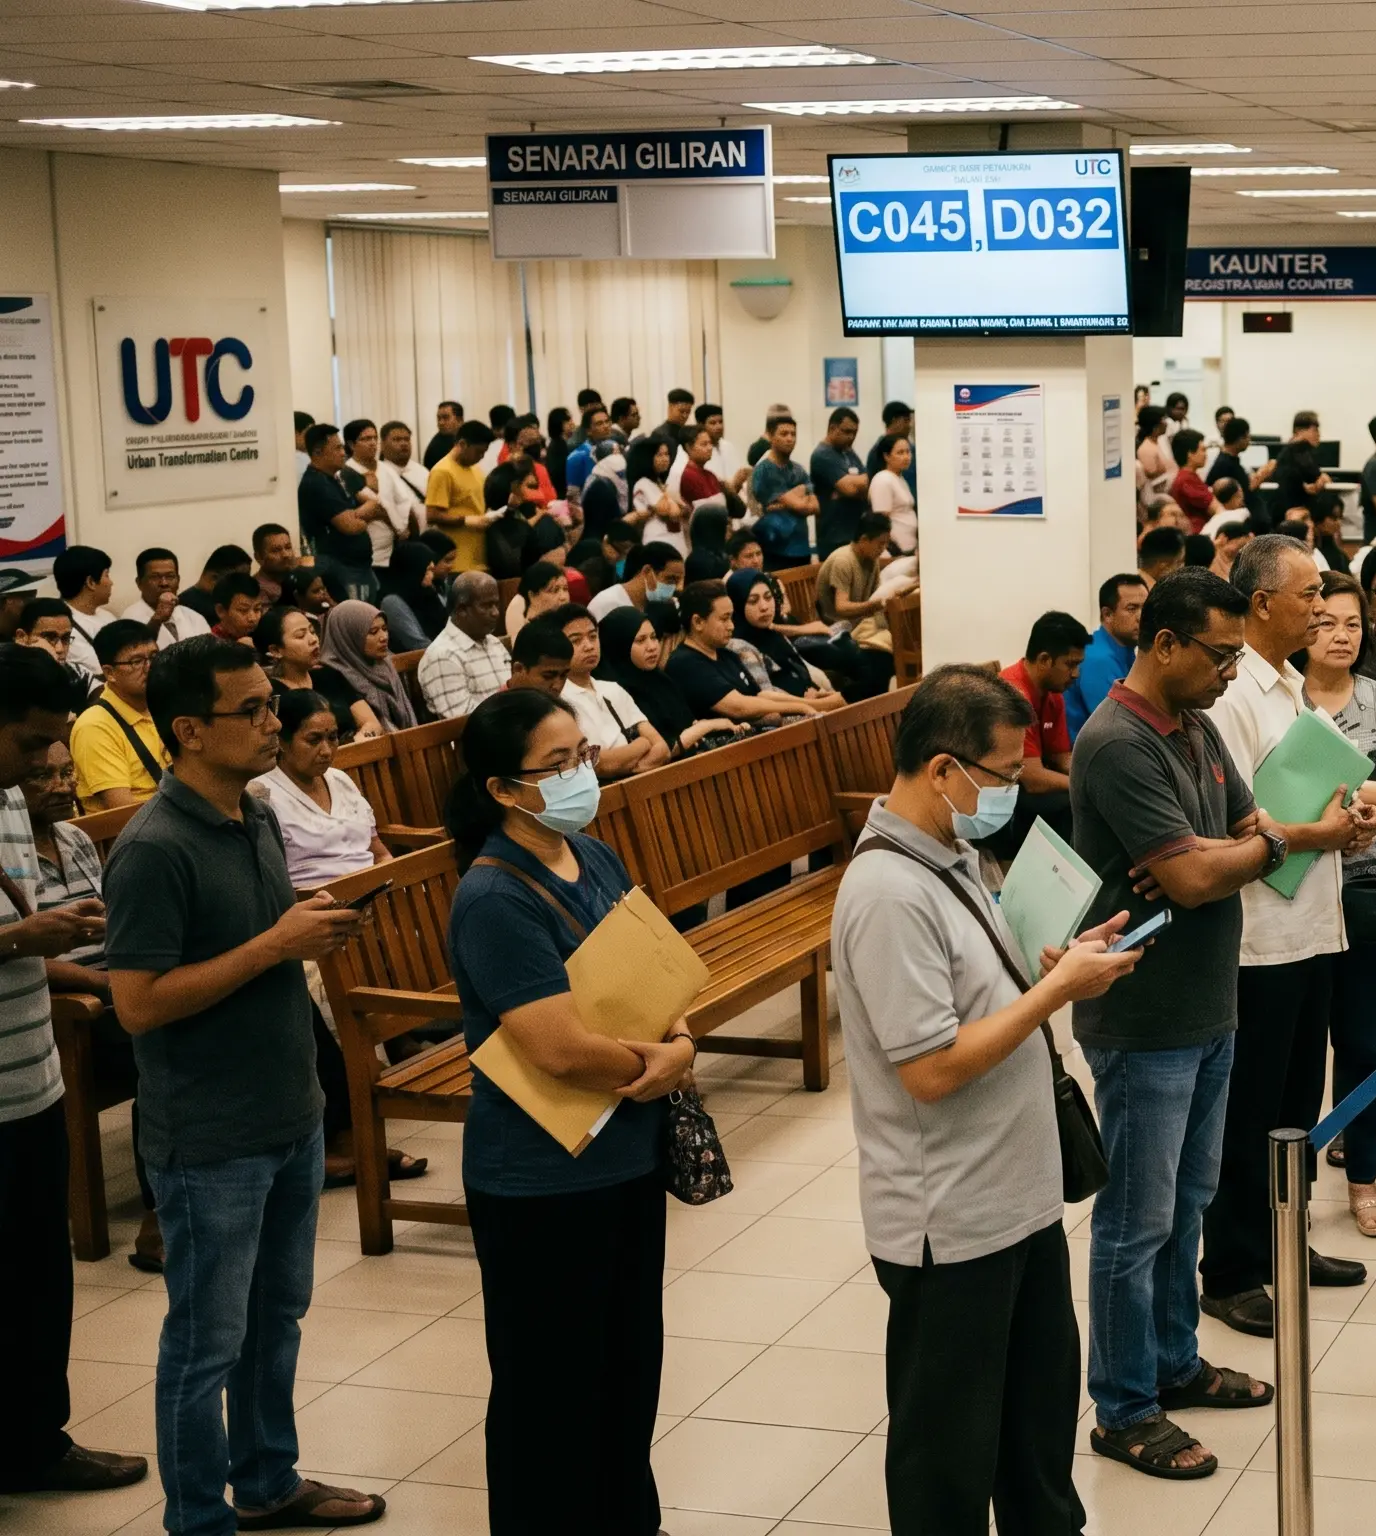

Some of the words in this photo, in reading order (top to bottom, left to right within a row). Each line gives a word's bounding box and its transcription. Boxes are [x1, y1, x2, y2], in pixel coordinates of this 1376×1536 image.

[507, 143, 626, 173] SENARAI
[635, 140, 747, 170] GILIRAN
[1075, 159, 1111, 175] UTC
[502, 190, 557, 203] SENARAI
[992, 198, 1113, 241] D032
[1209, 254, 1328, 274] KAUNTER
[1287, 278, 1354, 290] COUNTER
[120, 337, 255, 425] UTC
[127, 454, 156, 469] Urban
